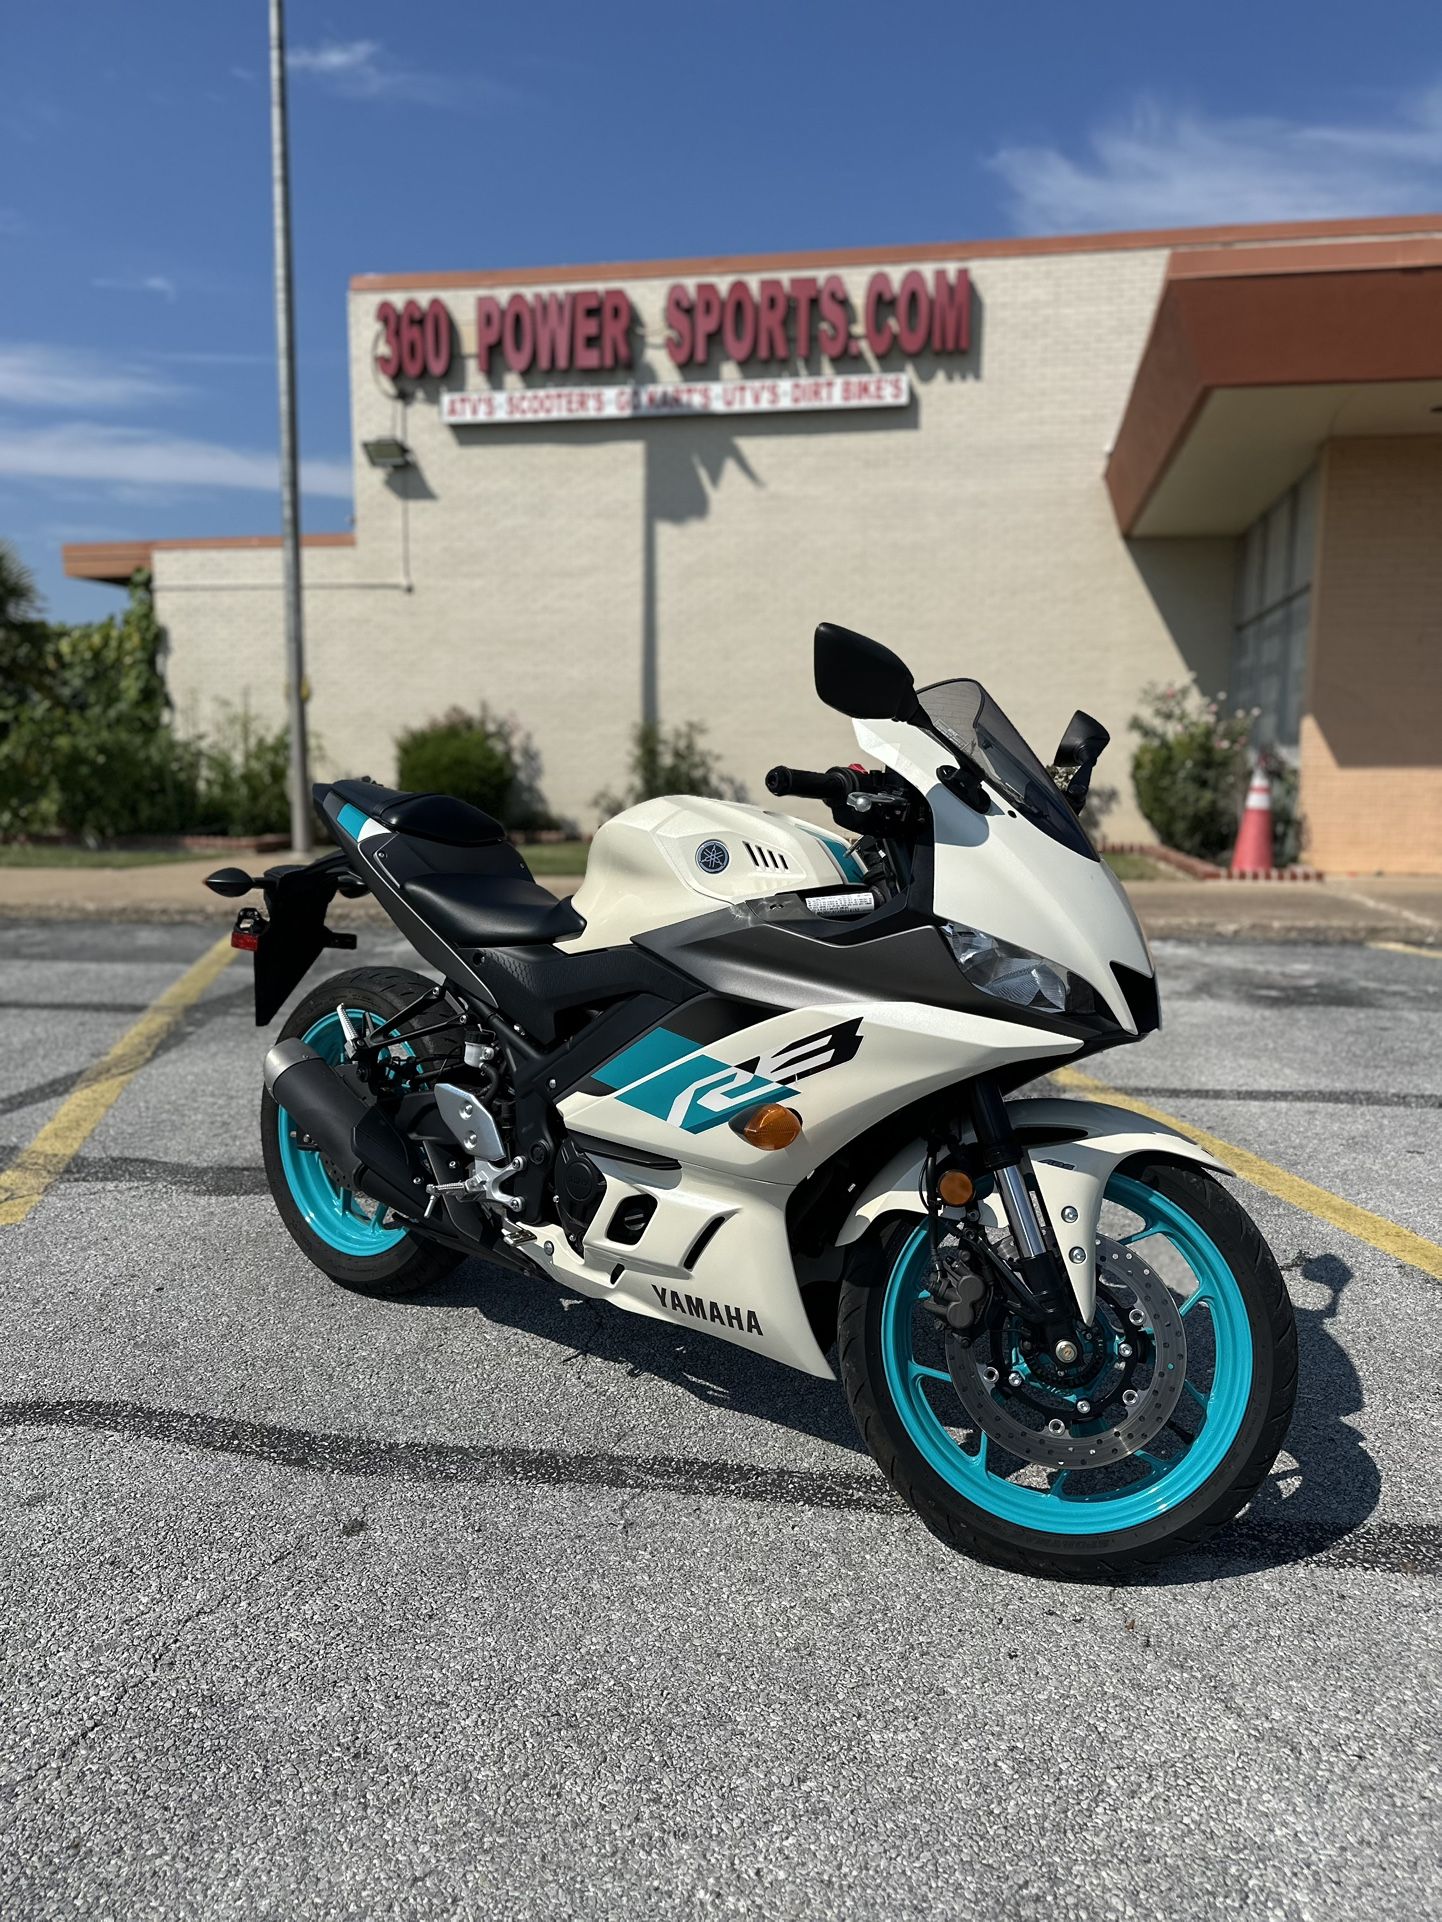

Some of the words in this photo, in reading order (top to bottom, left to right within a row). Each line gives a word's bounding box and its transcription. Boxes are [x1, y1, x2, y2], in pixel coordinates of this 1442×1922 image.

[376, 298, 451, 379] 360
[476, 289, 632, 375] POWER
[664, 268, 972, 366] SPORTS.COM
[722, 383, 780, 407] UTV'S
[790, 381, 834, 404] DIRT
[841, 377, 903, 402] BIKE'S
[650, 1284, 764, 1336] YAMAHA
